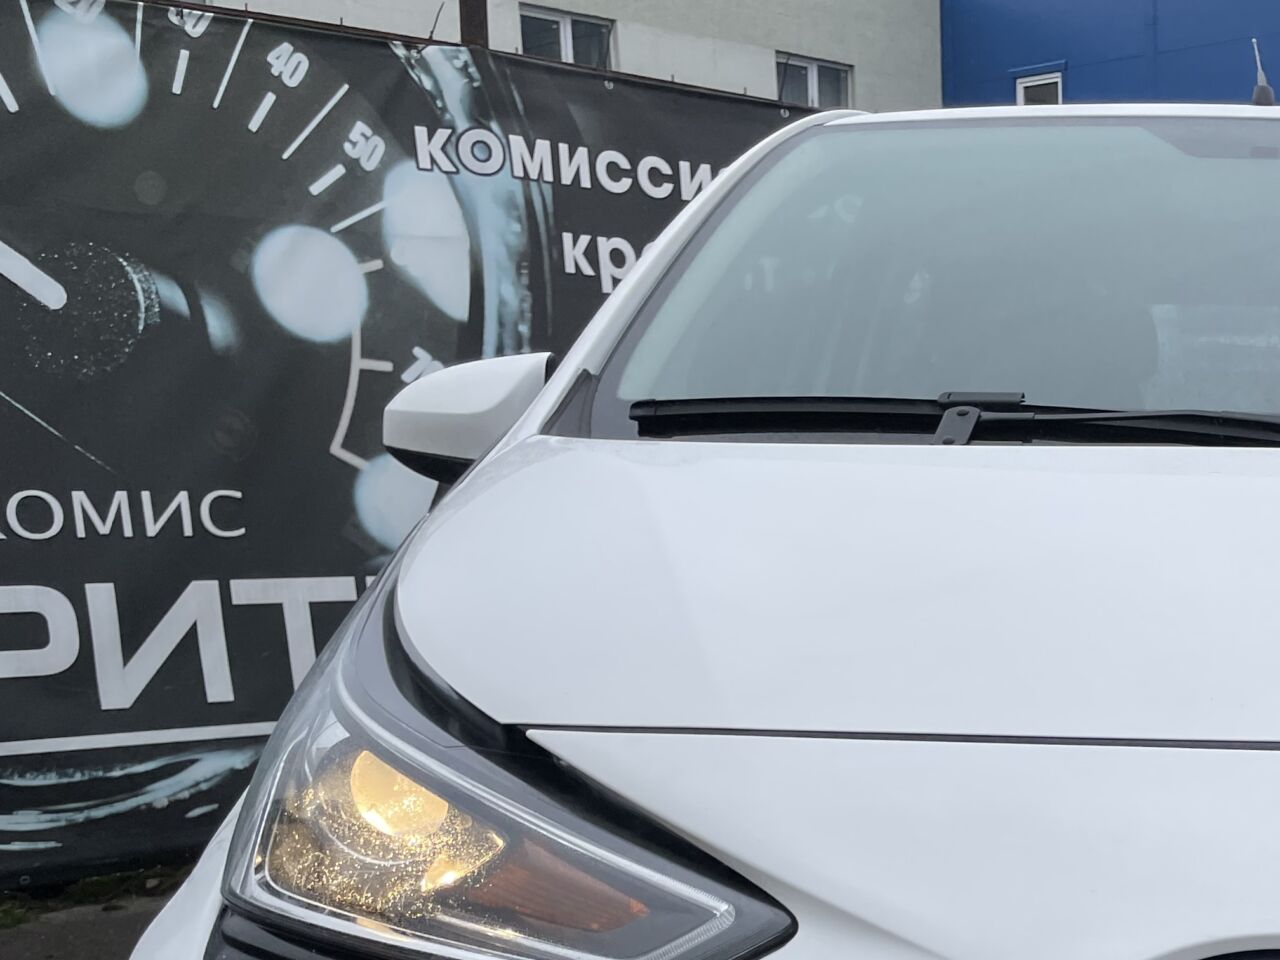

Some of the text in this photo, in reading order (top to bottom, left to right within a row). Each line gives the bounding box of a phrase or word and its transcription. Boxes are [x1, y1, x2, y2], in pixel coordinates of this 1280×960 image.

[266, 42, 309, 88] 40
[343, 121, 386, 172] 50
[561, 231, 656, 294] кр
[0, 489, 247, 540] ОМИС
[0, 575, 381, 711] РИТ
